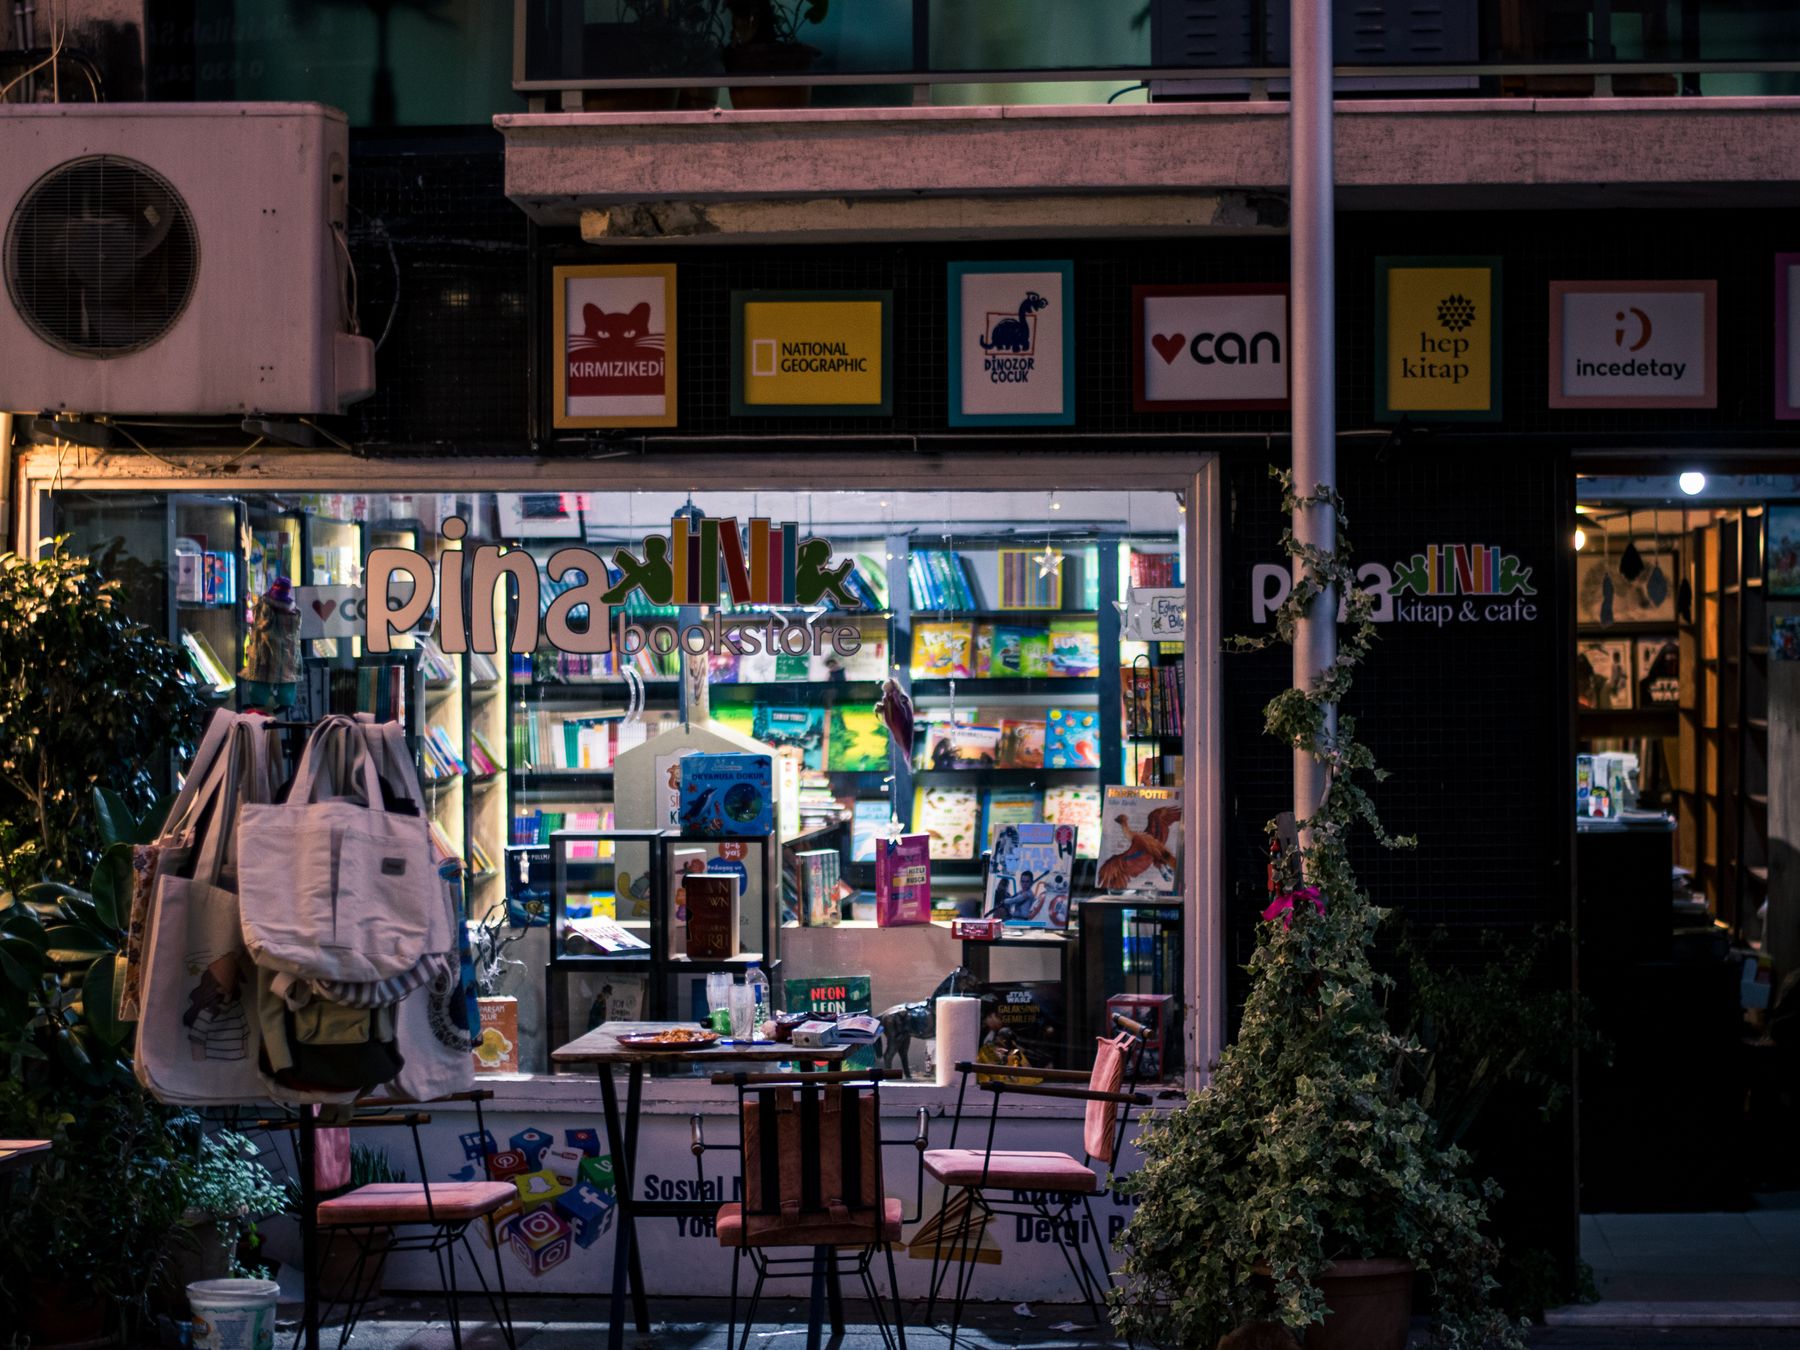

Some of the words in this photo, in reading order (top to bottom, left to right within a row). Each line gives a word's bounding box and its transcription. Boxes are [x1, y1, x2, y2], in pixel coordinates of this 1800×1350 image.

[781, 342, 849, 357] NATIONAL
[1190, 331, 1281, 365] can
[1420, 331, 1470, 357] hep
[780, 357, 868, 373] GEOGRAPHIC
[1401, 357, 1470, 384] kitap
[1576, 358, 1687, 380] incedetay
[365, 515, 613, 655] pina
[1252, 563, 1394, 624] pa
[1397, 599, 1453, 628] kitap
[1458, 600, 1480, 622] &
[618, 607, 862, 657] bookstore
[810, 986, 846, 1001] NEON
[812, 1001, 846, 1013] LEON
[1015, 1214, 1089, 1247] Dergi
